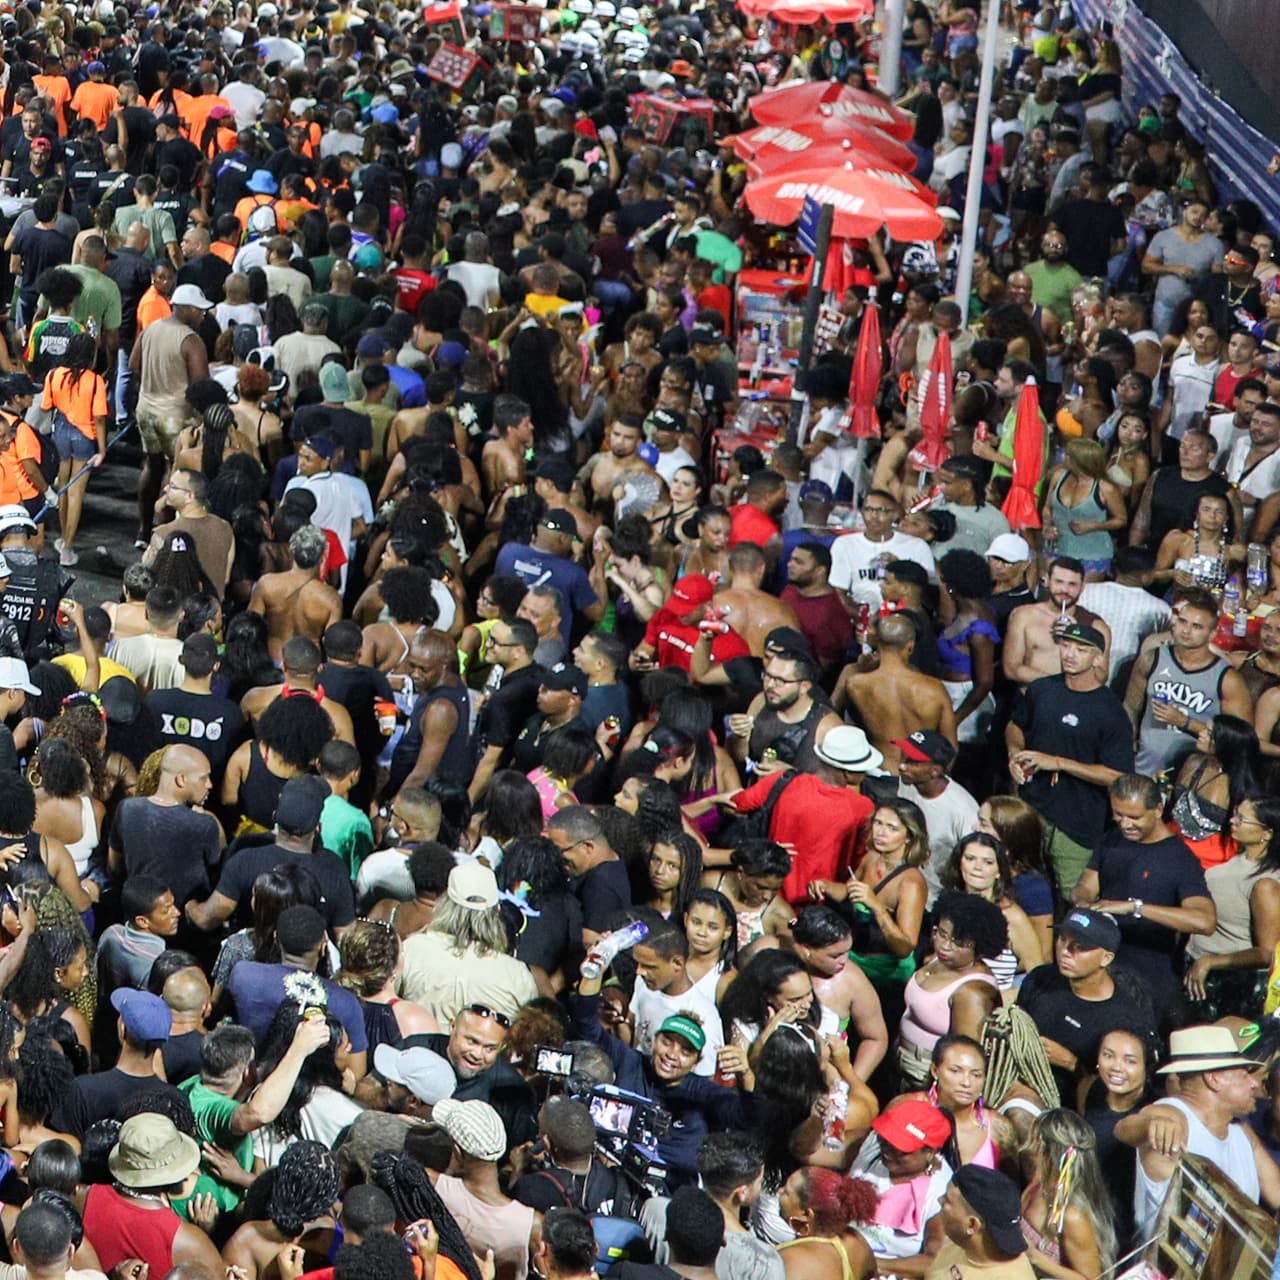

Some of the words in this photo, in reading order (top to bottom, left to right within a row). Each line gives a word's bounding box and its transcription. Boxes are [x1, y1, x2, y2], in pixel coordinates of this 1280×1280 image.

[775, 182, 865, 214] BRAHMA
[1154, 682, 1214, 714] BKLYN
[161, 713, 224, 741] XODÓ
